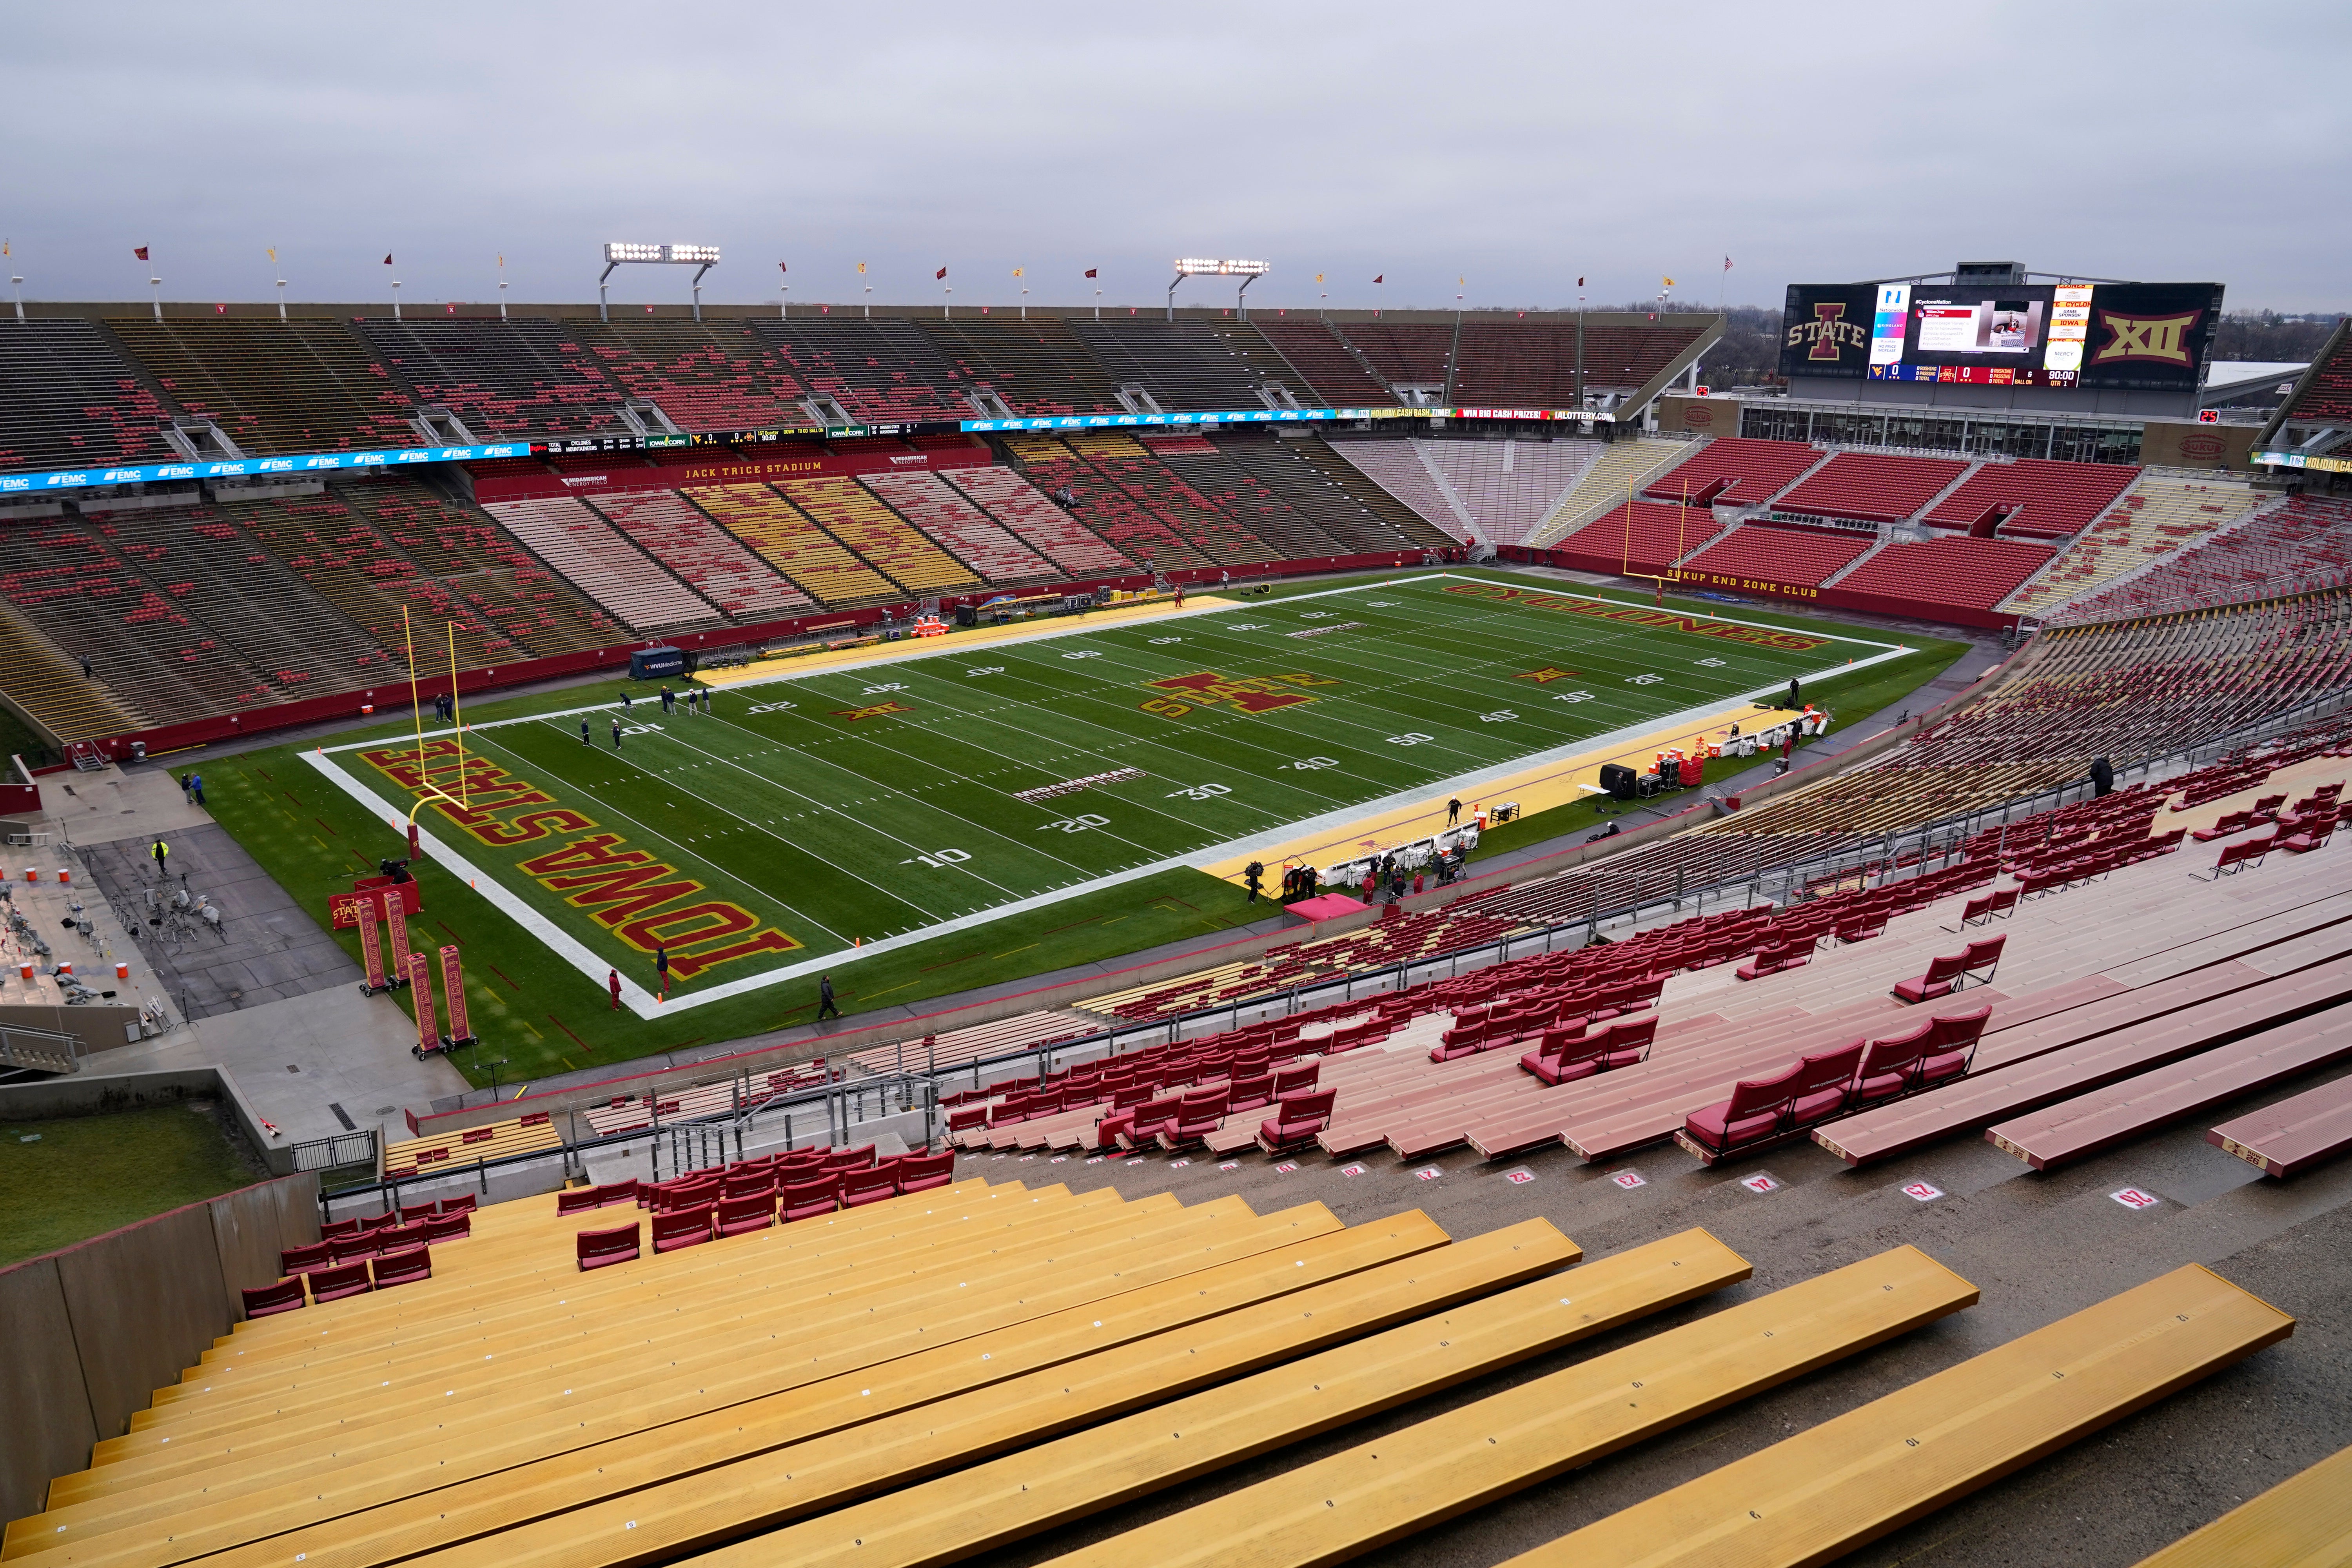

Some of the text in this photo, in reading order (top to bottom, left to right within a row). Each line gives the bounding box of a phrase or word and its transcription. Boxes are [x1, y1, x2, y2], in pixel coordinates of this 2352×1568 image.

[1788, 321, 1865, 348] STATE
[1891, 365, 1899, 375] 0
[1963, 367, 1970, 377] 0
[2049, 370, 2074, 380] 90:00
[1697, 387, 1707, 396] 25
[1431, 408, 1450, 417] TIME!
[1463, 409, 1613, 421] WIN BIG CASH PRIZES! IALOTTERY.COM
[1686, 410, 1710, 422] Sukup
[2201, 411, 2216, 422] 25
[494, 446, 512, 455] EMC
[2183, 439, 2221, 454] Sukup
[365, 454, 385, 462] EMC
[409, 452, 429, 460] EMC
[452, 449, 471, 457] EMC
[222, 463, 244, 472] EMC
[271, 460, 292, 468] EMC
[319, 457, 339, 466] EMC
[2289, 455, 2305, 467] IT'S
[2305, 456, 2339, 471] HOLIDAY
[118, 470, 141, 479] EMC
[171, 467, 194, 475] EMC
[686, 462, 821, 478] JACK TRICE STADIUM
[62, 474, 86, 483] EMC
[1667, 569, 1817, 598] SUKUP END ZONE CLUB
[1441, 583, 1834, 650] CYCLONES
[650, 660, 682, 669] WVUMedicine
[1693, 657, 1726, 667] 10
[1624, 674, 1664, 685] 20
[1138, 673, 1344, 718] STATE
[1552, 691, 1595, 703] 30
[1479, 711, 1519, 723] 40
[1385, 732, 1434, 746] 50
[1295, 757, 1339, 770] 40
[1013, 767, 1138, 799] MIDAMERICAN
[1023, 771, 1147, 803] ENERGY FIELD
[355, 739, 600, 847] STATE
[1178, 784, 1232, 800] 30
[1051, 814, 1111, 834] 20
[916, 848, 972, 868] 10
[516, 833, 805, 982] IOWA
[392, 914, 408, 967] CYCLONES
[364, 921, 381, 975] CYCLONES
[448, 971, 465, 1028] CYCLONES
[417, 978, 434, 1036] CYCLONES
[2013, 1149, 2023, 1159] 25
[2014, 1145, 2025, 1154] ROW
[1279, 1164, 1294, 1172] 19
[1344, 1167, 1361, 1176] 20
[1417, 1171, 1437, 1180] 21
[1509, 1172, 1531, 1182] 22
[1618, 1174, 1643, 1185] 23
[1750, 1178, 1775, 1191] 24
[1906, 1184, 1934, 1198] 25
[2126, 1190, 2152, 1207] 26
